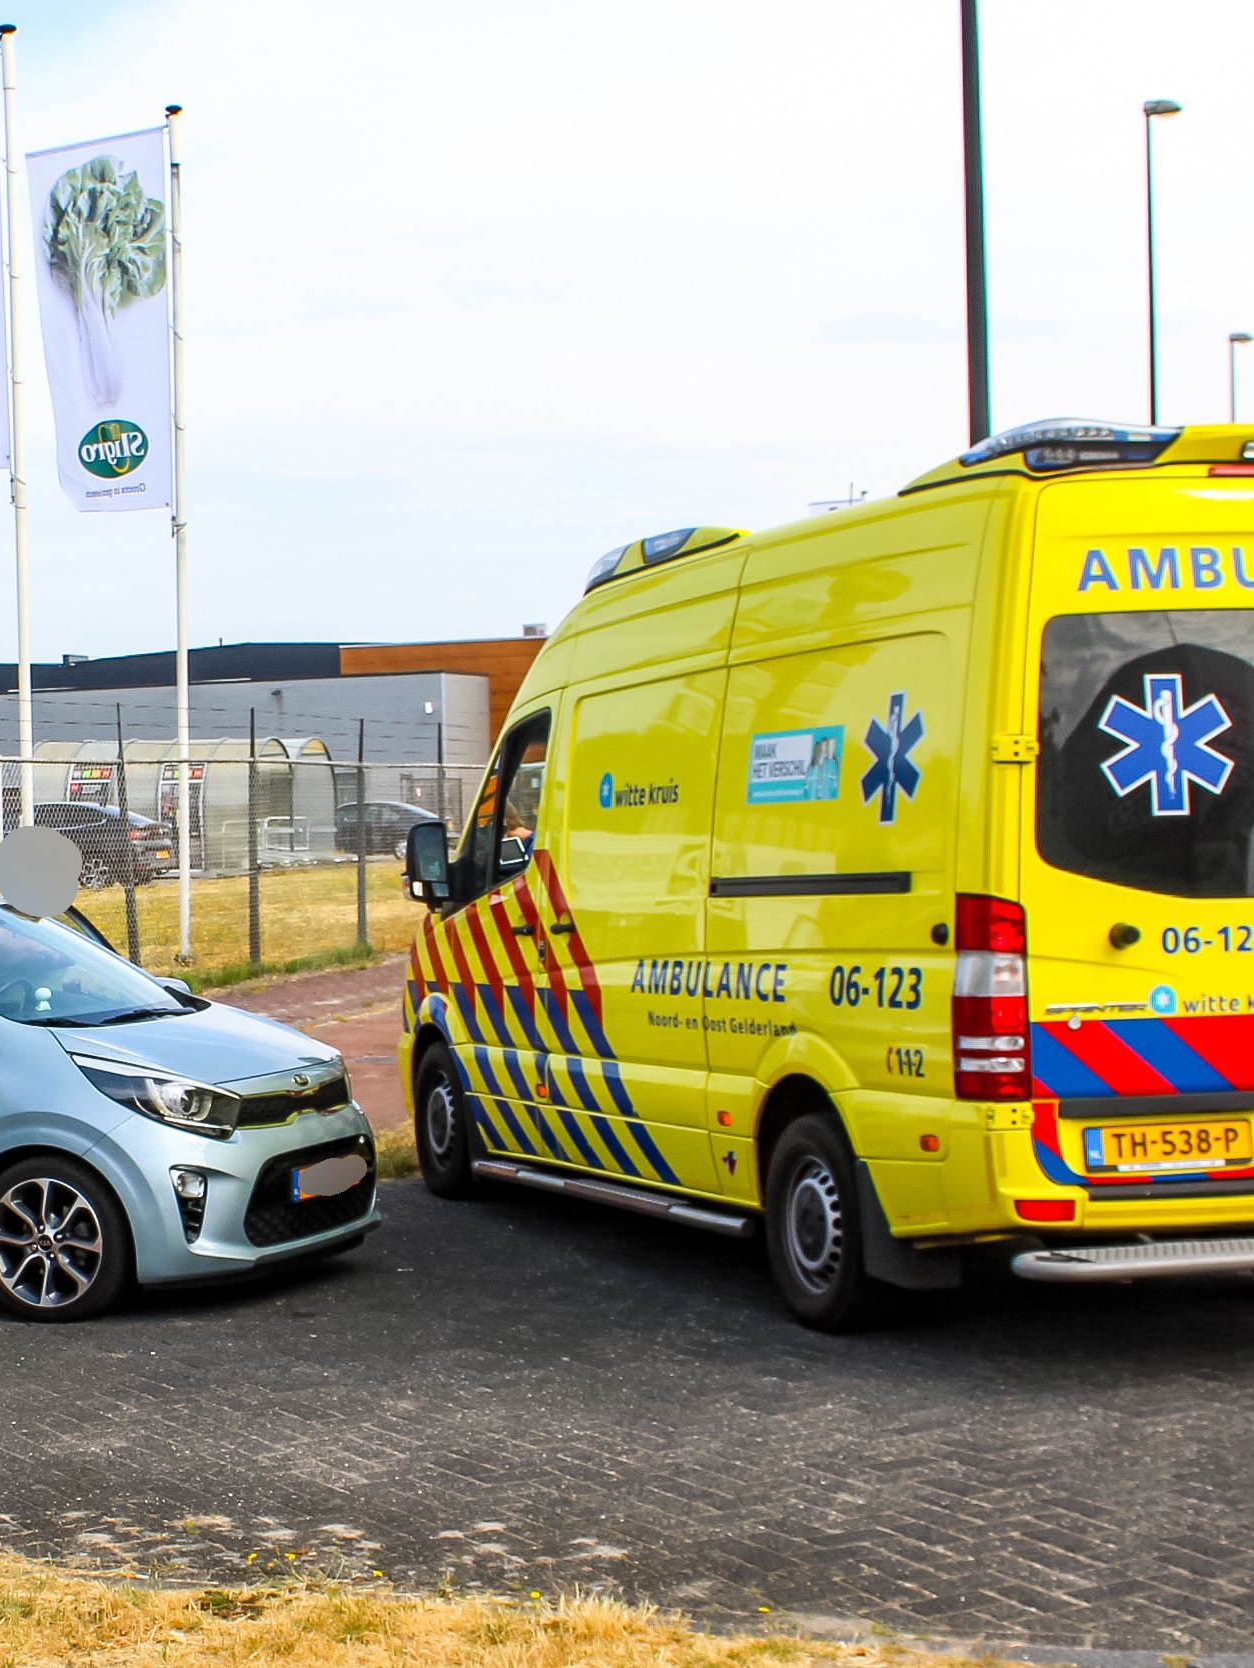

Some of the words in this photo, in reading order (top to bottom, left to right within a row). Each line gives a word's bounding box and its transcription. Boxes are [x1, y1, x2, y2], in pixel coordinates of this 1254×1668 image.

[1077, 547, 1254, 592] AMBU
[615, 783, 645, 807] witte
[648, 778, 679, 805] kruis
[1161, 925, 1254, 954] 06-12
[631, 958, 788, 1003] AMBULANCE
[829, 965, 922, 1010] 06-123
[1183, 994, 1241, 1013] witte
[648, 1011, 683, 1028] Noord-
[686, 1016, 699, 1030] en
[703, 1016, 728, 1033] Oost
[730, 1018, 797, 1037] Gelderland
[1111, 1127, 1239, 1159] TH-538-P
